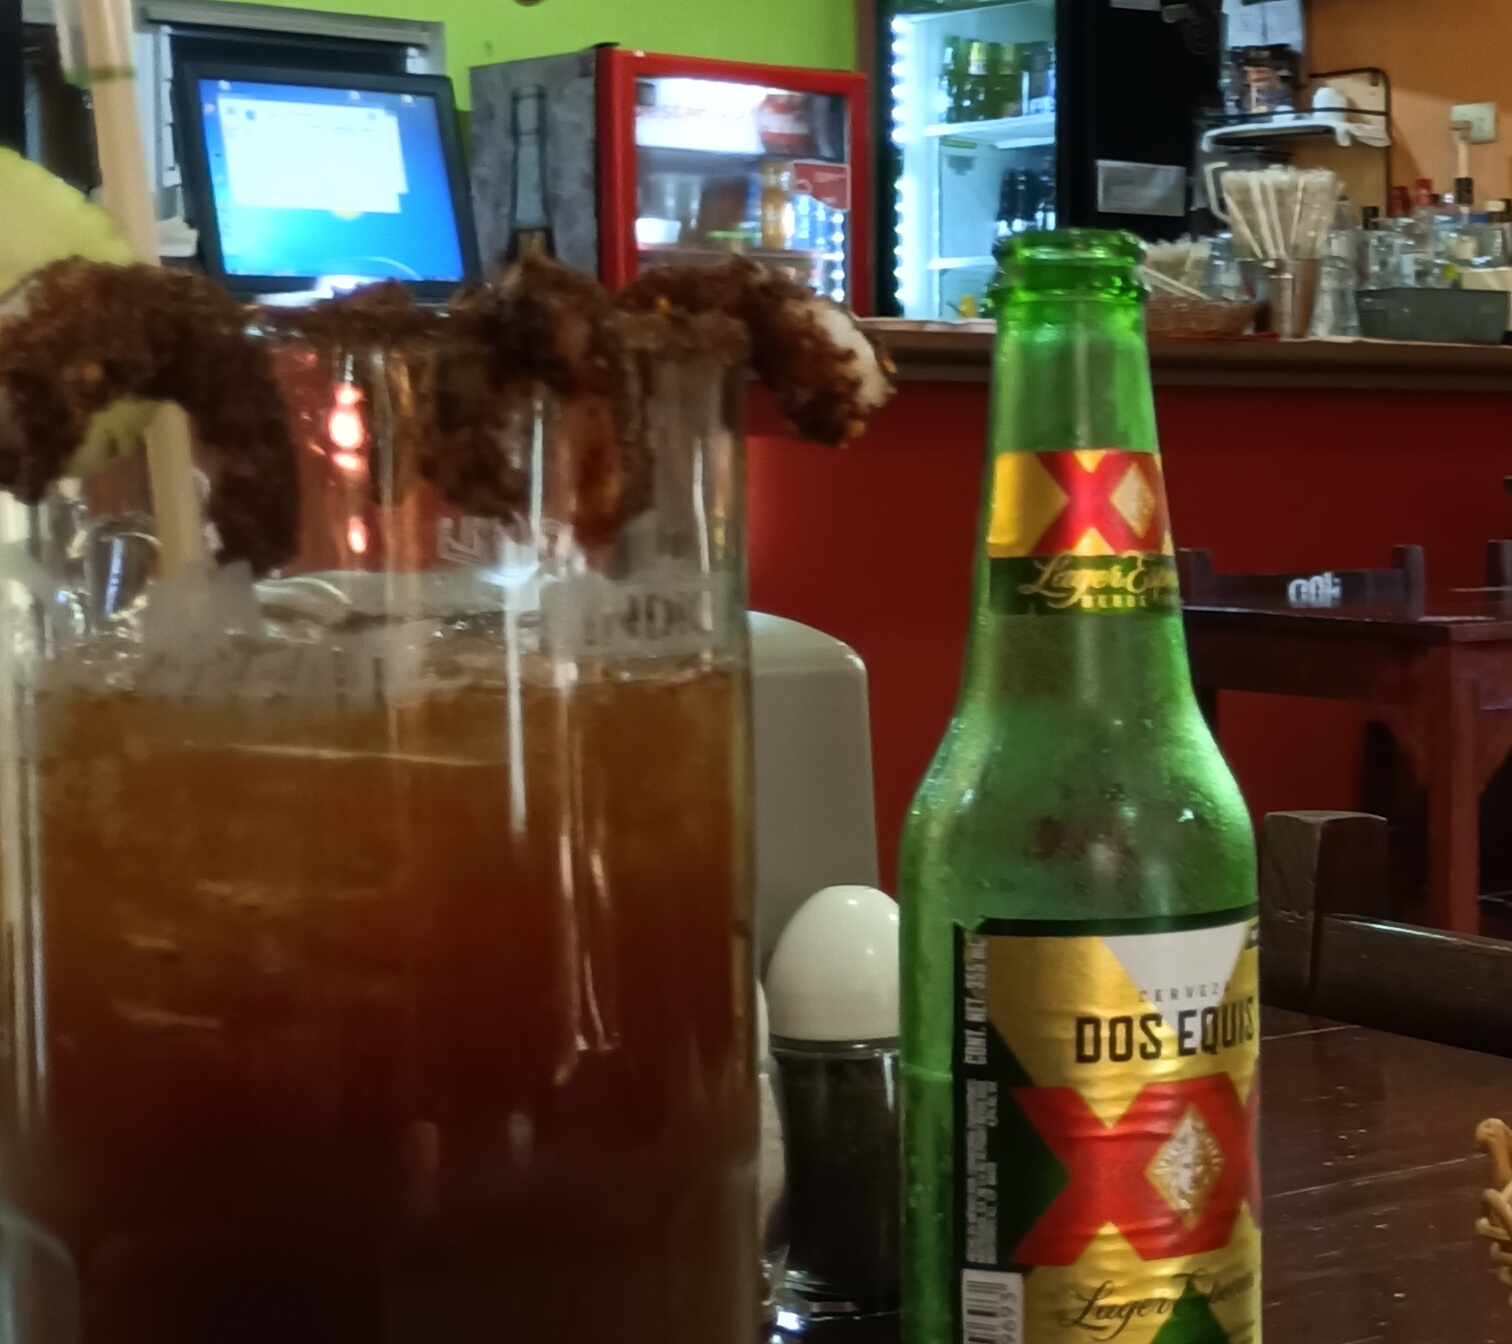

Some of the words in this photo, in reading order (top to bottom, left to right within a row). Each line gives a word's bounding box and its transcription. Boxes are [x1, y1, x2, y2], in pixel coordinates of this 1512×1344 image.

[1075, 1013, 1163, 1064] DOS
[1178, 996, 1255, 1056] EQUIS
[1058, 1279, 1174, 1343] Lager
